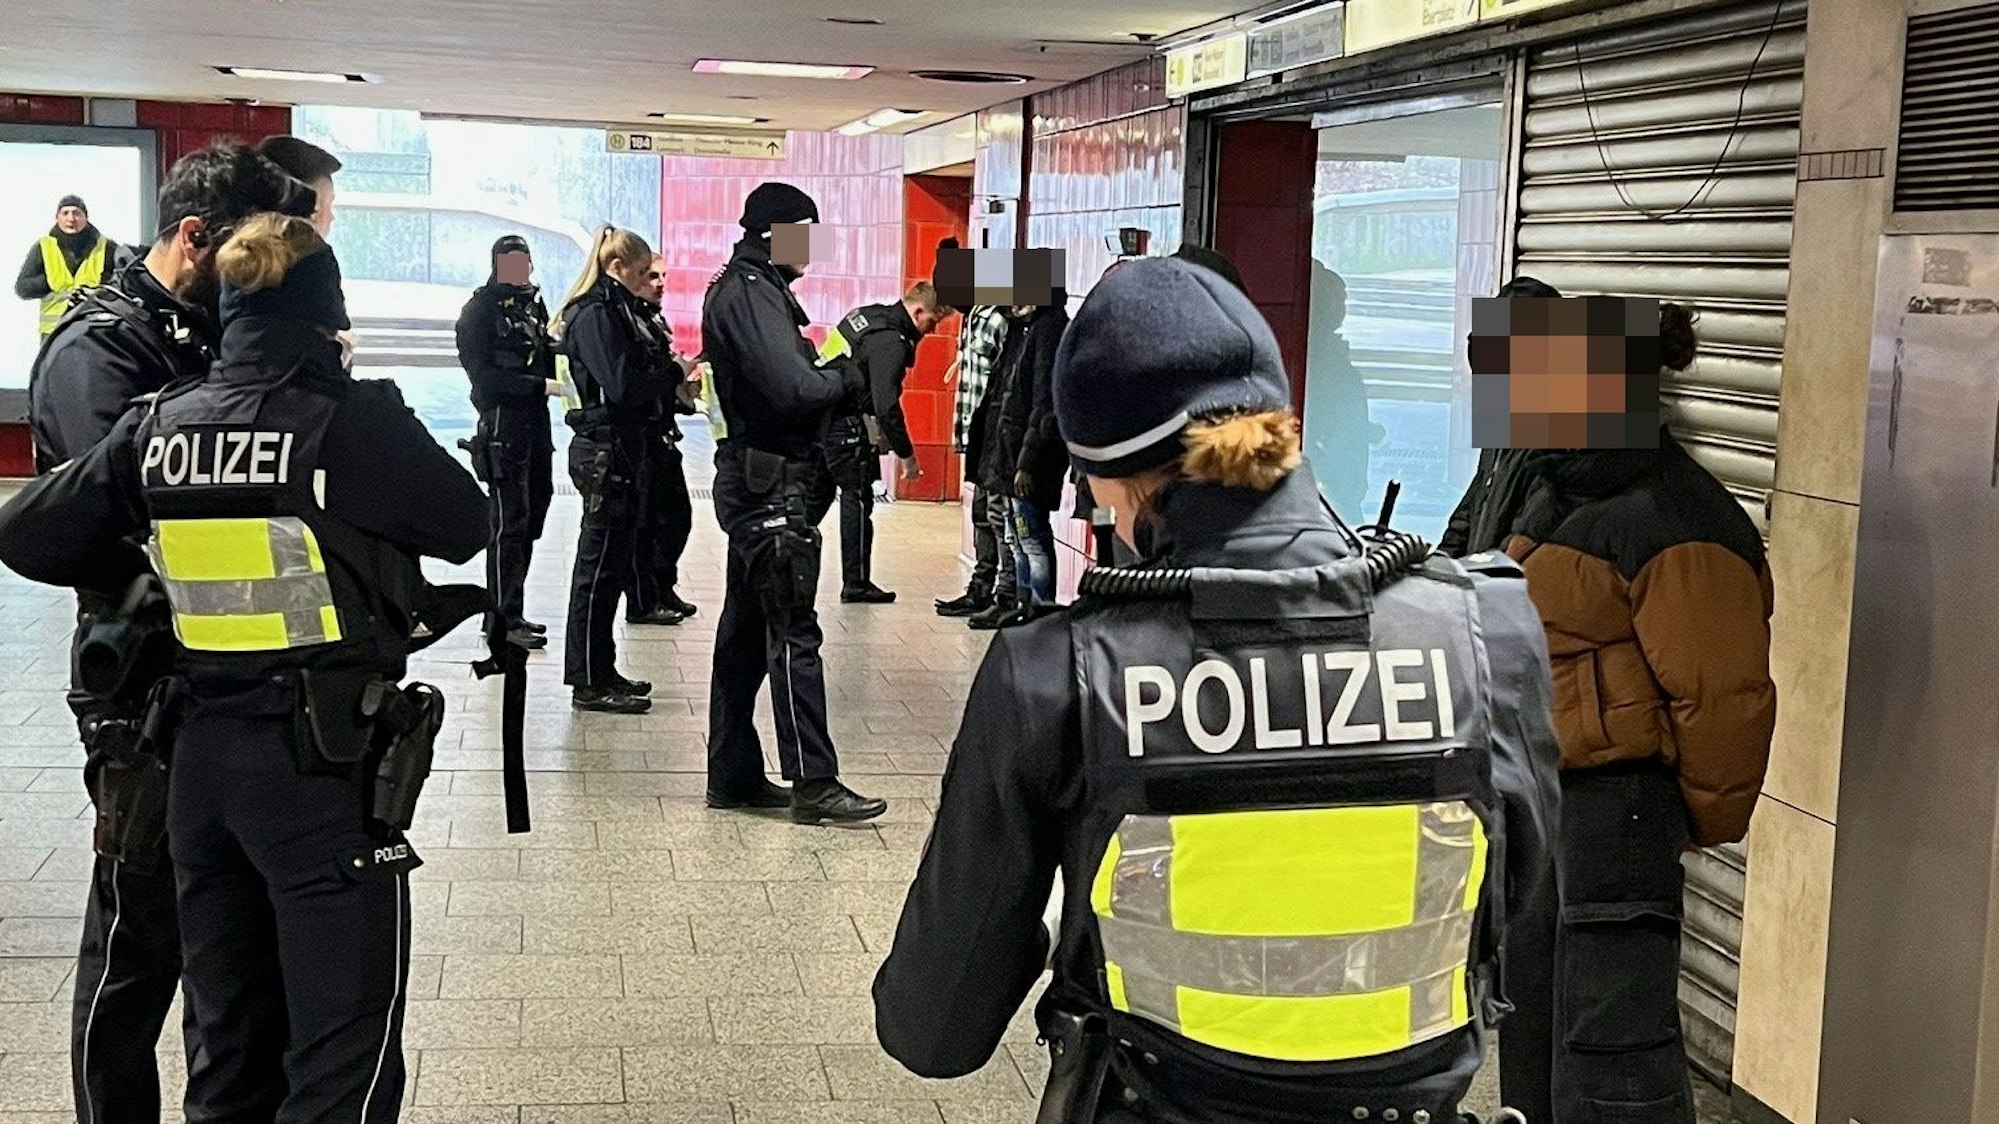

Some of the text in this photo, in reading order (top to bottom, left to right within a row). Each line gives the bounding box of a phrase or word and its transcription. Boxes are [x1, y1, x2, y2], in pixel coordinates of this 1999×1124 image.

[631, 136, 651, 149] 184
[141, 432, 294, 486] POLIZEI
[1124, 648, 1455, 757] POLIZEI
